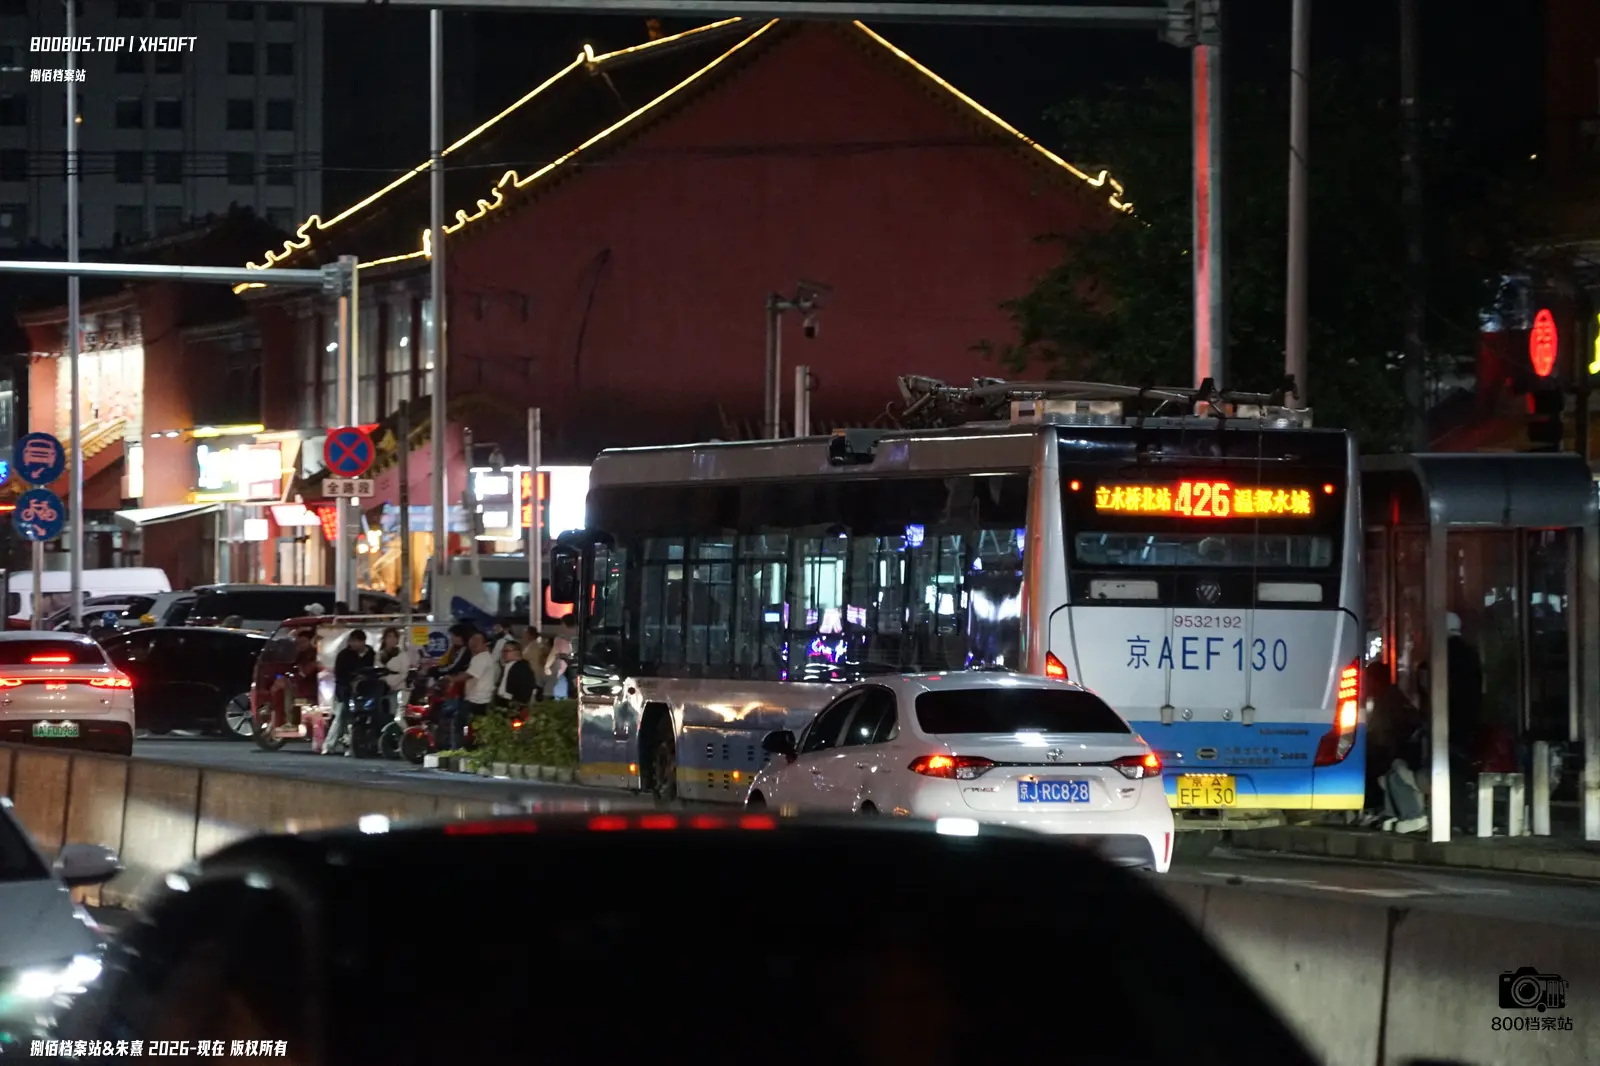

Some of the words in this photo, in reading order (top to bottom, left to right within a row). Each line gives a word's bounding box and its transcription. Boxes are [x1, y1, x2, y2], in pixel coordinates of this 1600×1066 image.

[327, 481, 370, 495] 全路段
[1096, 487, 1171, 511] 立水桥北站
[1174, 482, 1230, 517] 426
[1234, 488, 1311, 514] 温都水城
[1174, 615, 1242, 629] 9532192
[1126, 635, 1288, 671] 京AEF130
[1180, 787, 1234, 805] EF130
